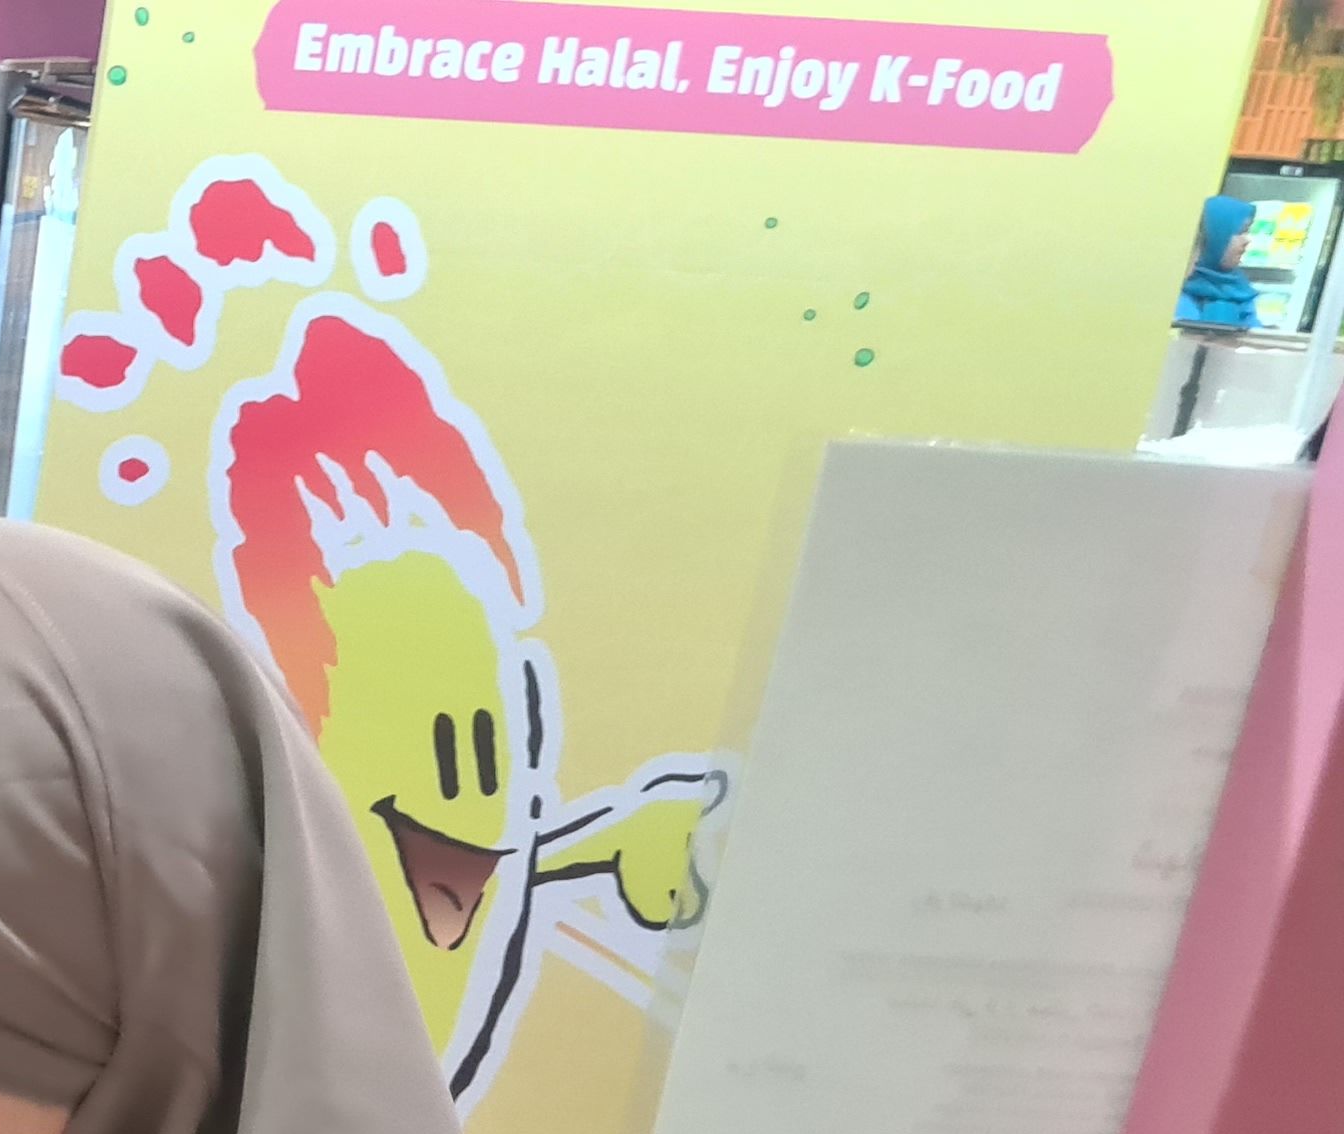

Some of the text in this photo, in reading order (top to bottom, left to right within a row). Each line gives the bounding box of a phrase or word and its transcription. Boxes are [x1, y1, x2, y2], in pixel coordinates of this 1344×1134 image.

[293, 22, 1064, 112] Embrace Halal, Enjoy K-Food
